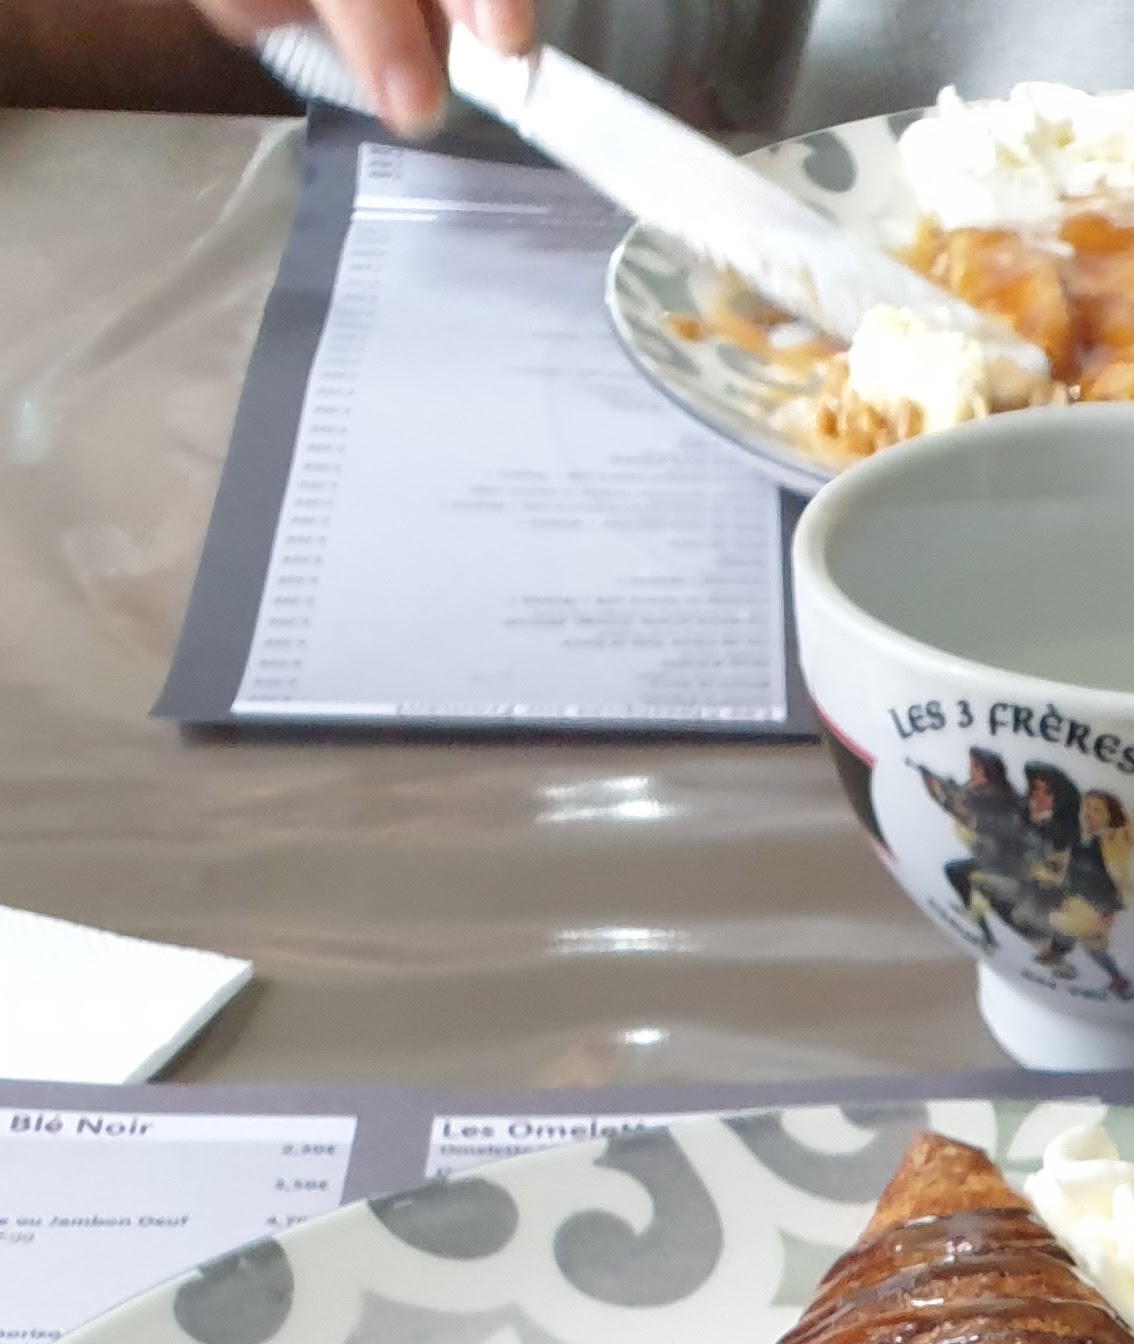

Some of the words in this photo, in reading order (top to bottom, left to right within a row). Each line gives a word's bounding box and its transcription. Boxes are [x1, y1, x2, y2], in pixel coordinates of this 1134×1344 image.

[888, 699, 946, 739] LES
[957, 699, 974, 729] 3
[10, 1112, 64, 1134] Blé
[77, 1116, 154, 1137] Noir
[443, 1120, 494, 1139] Les
